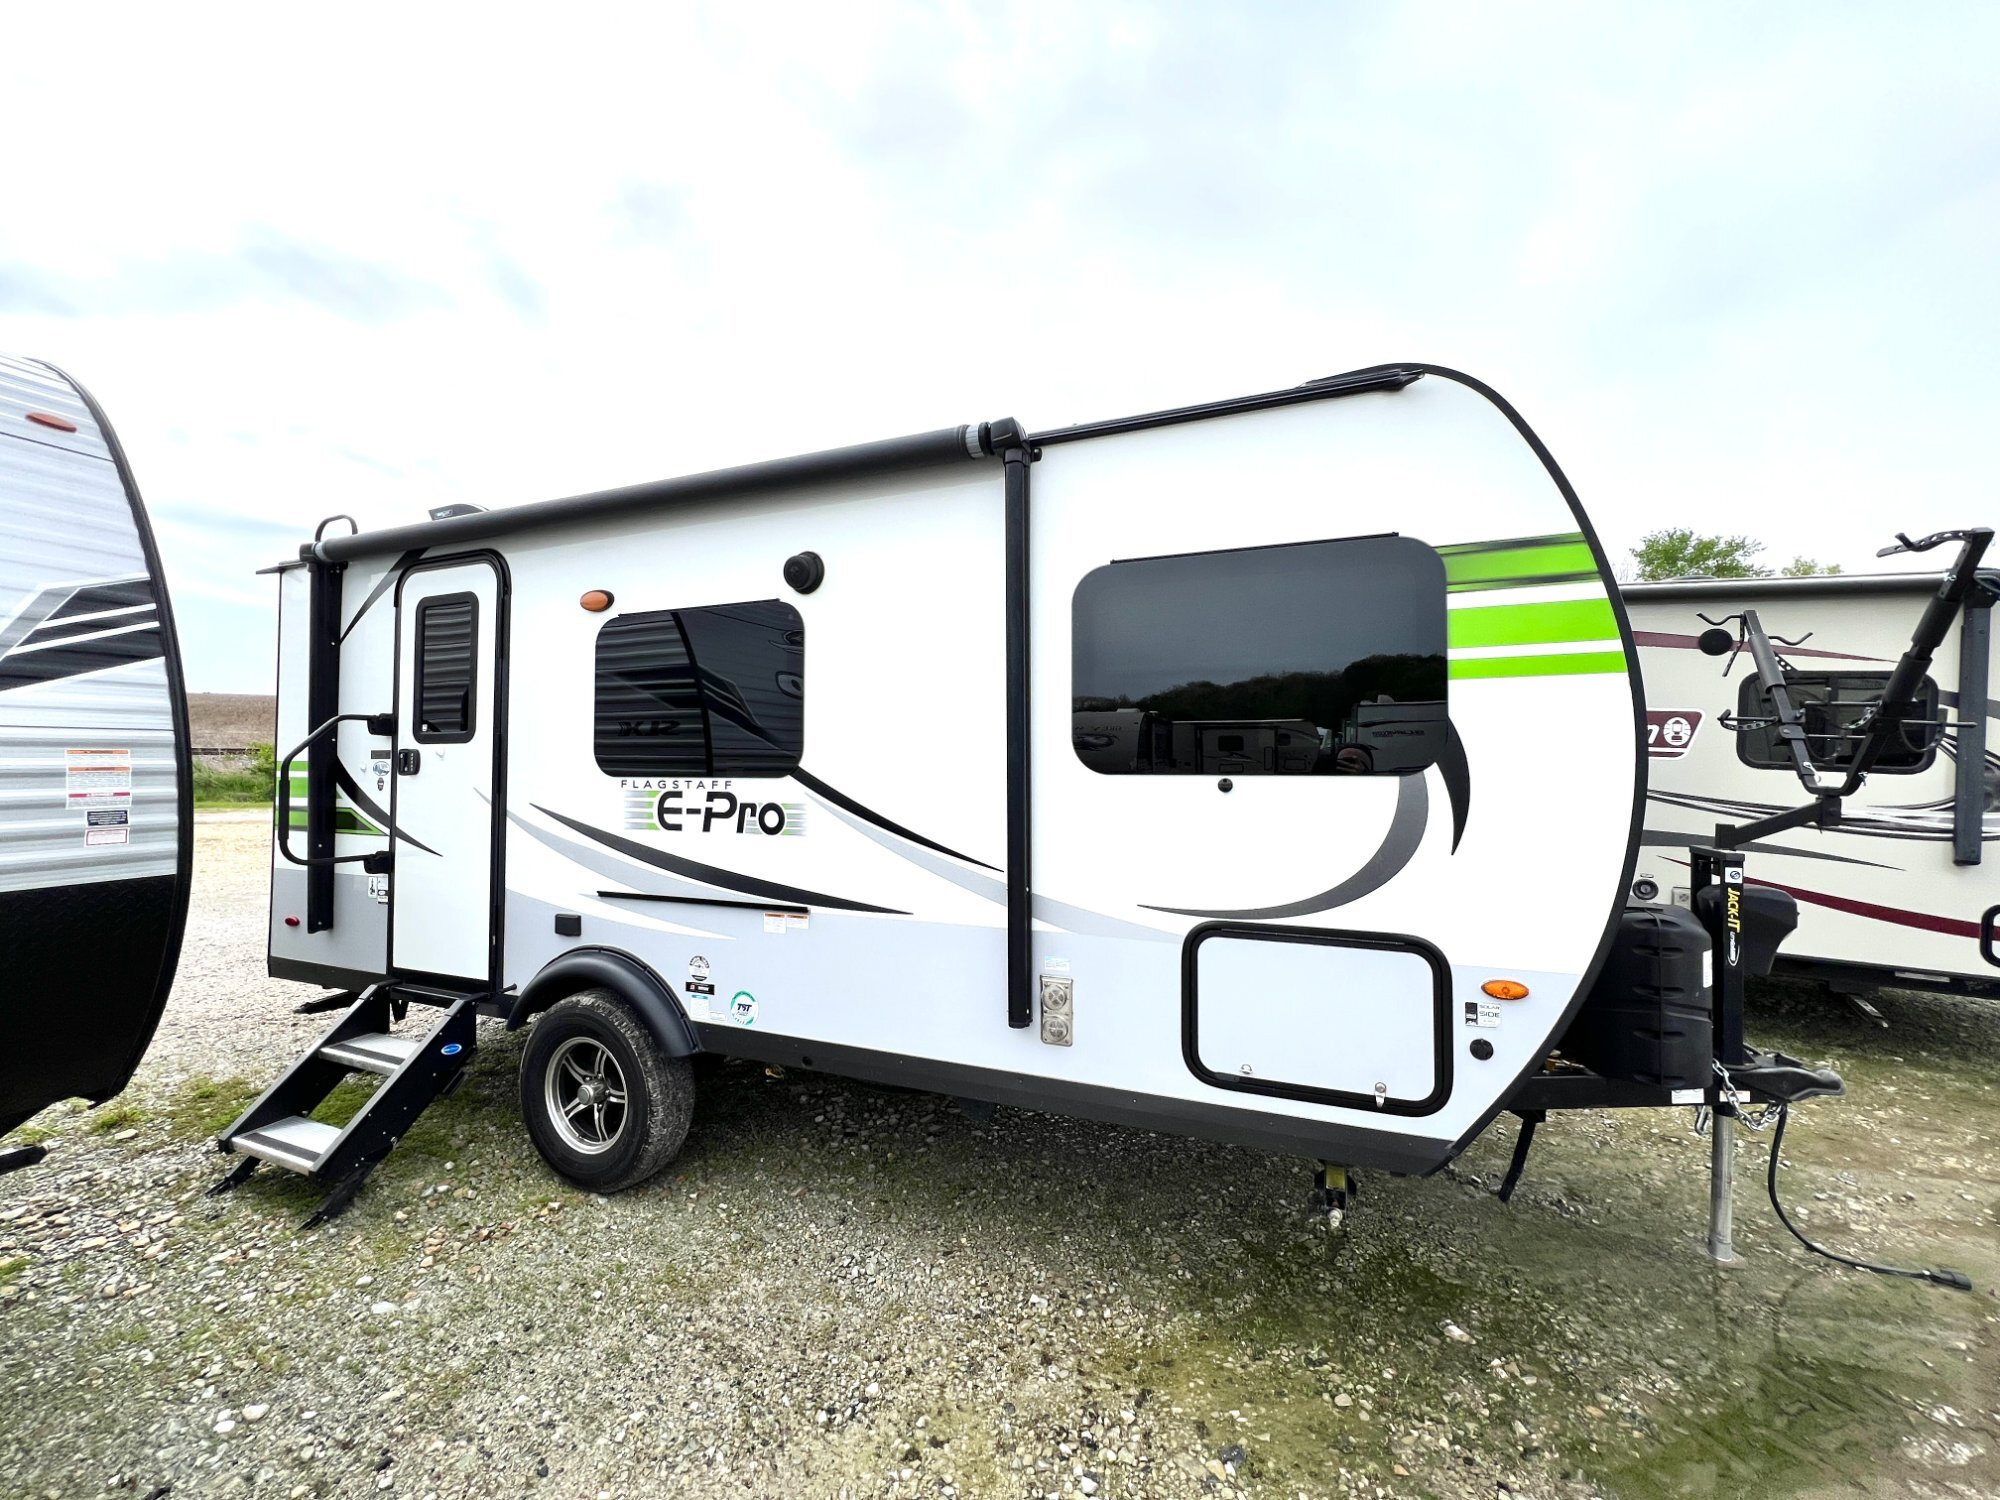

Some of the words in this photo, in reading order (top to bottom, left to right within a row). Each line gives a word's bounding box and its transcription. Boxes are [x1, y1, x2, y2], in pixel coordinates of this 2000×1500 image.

[620, 780, 732, 790] FLAGSTAFF
[657, 790, 786, 836] E-Pro
[1727, 887, 1741, 933] JACK-IT
[737, 1003, 752, 1012] TST
[1479, 1010, 1500, 1018] SIDE
